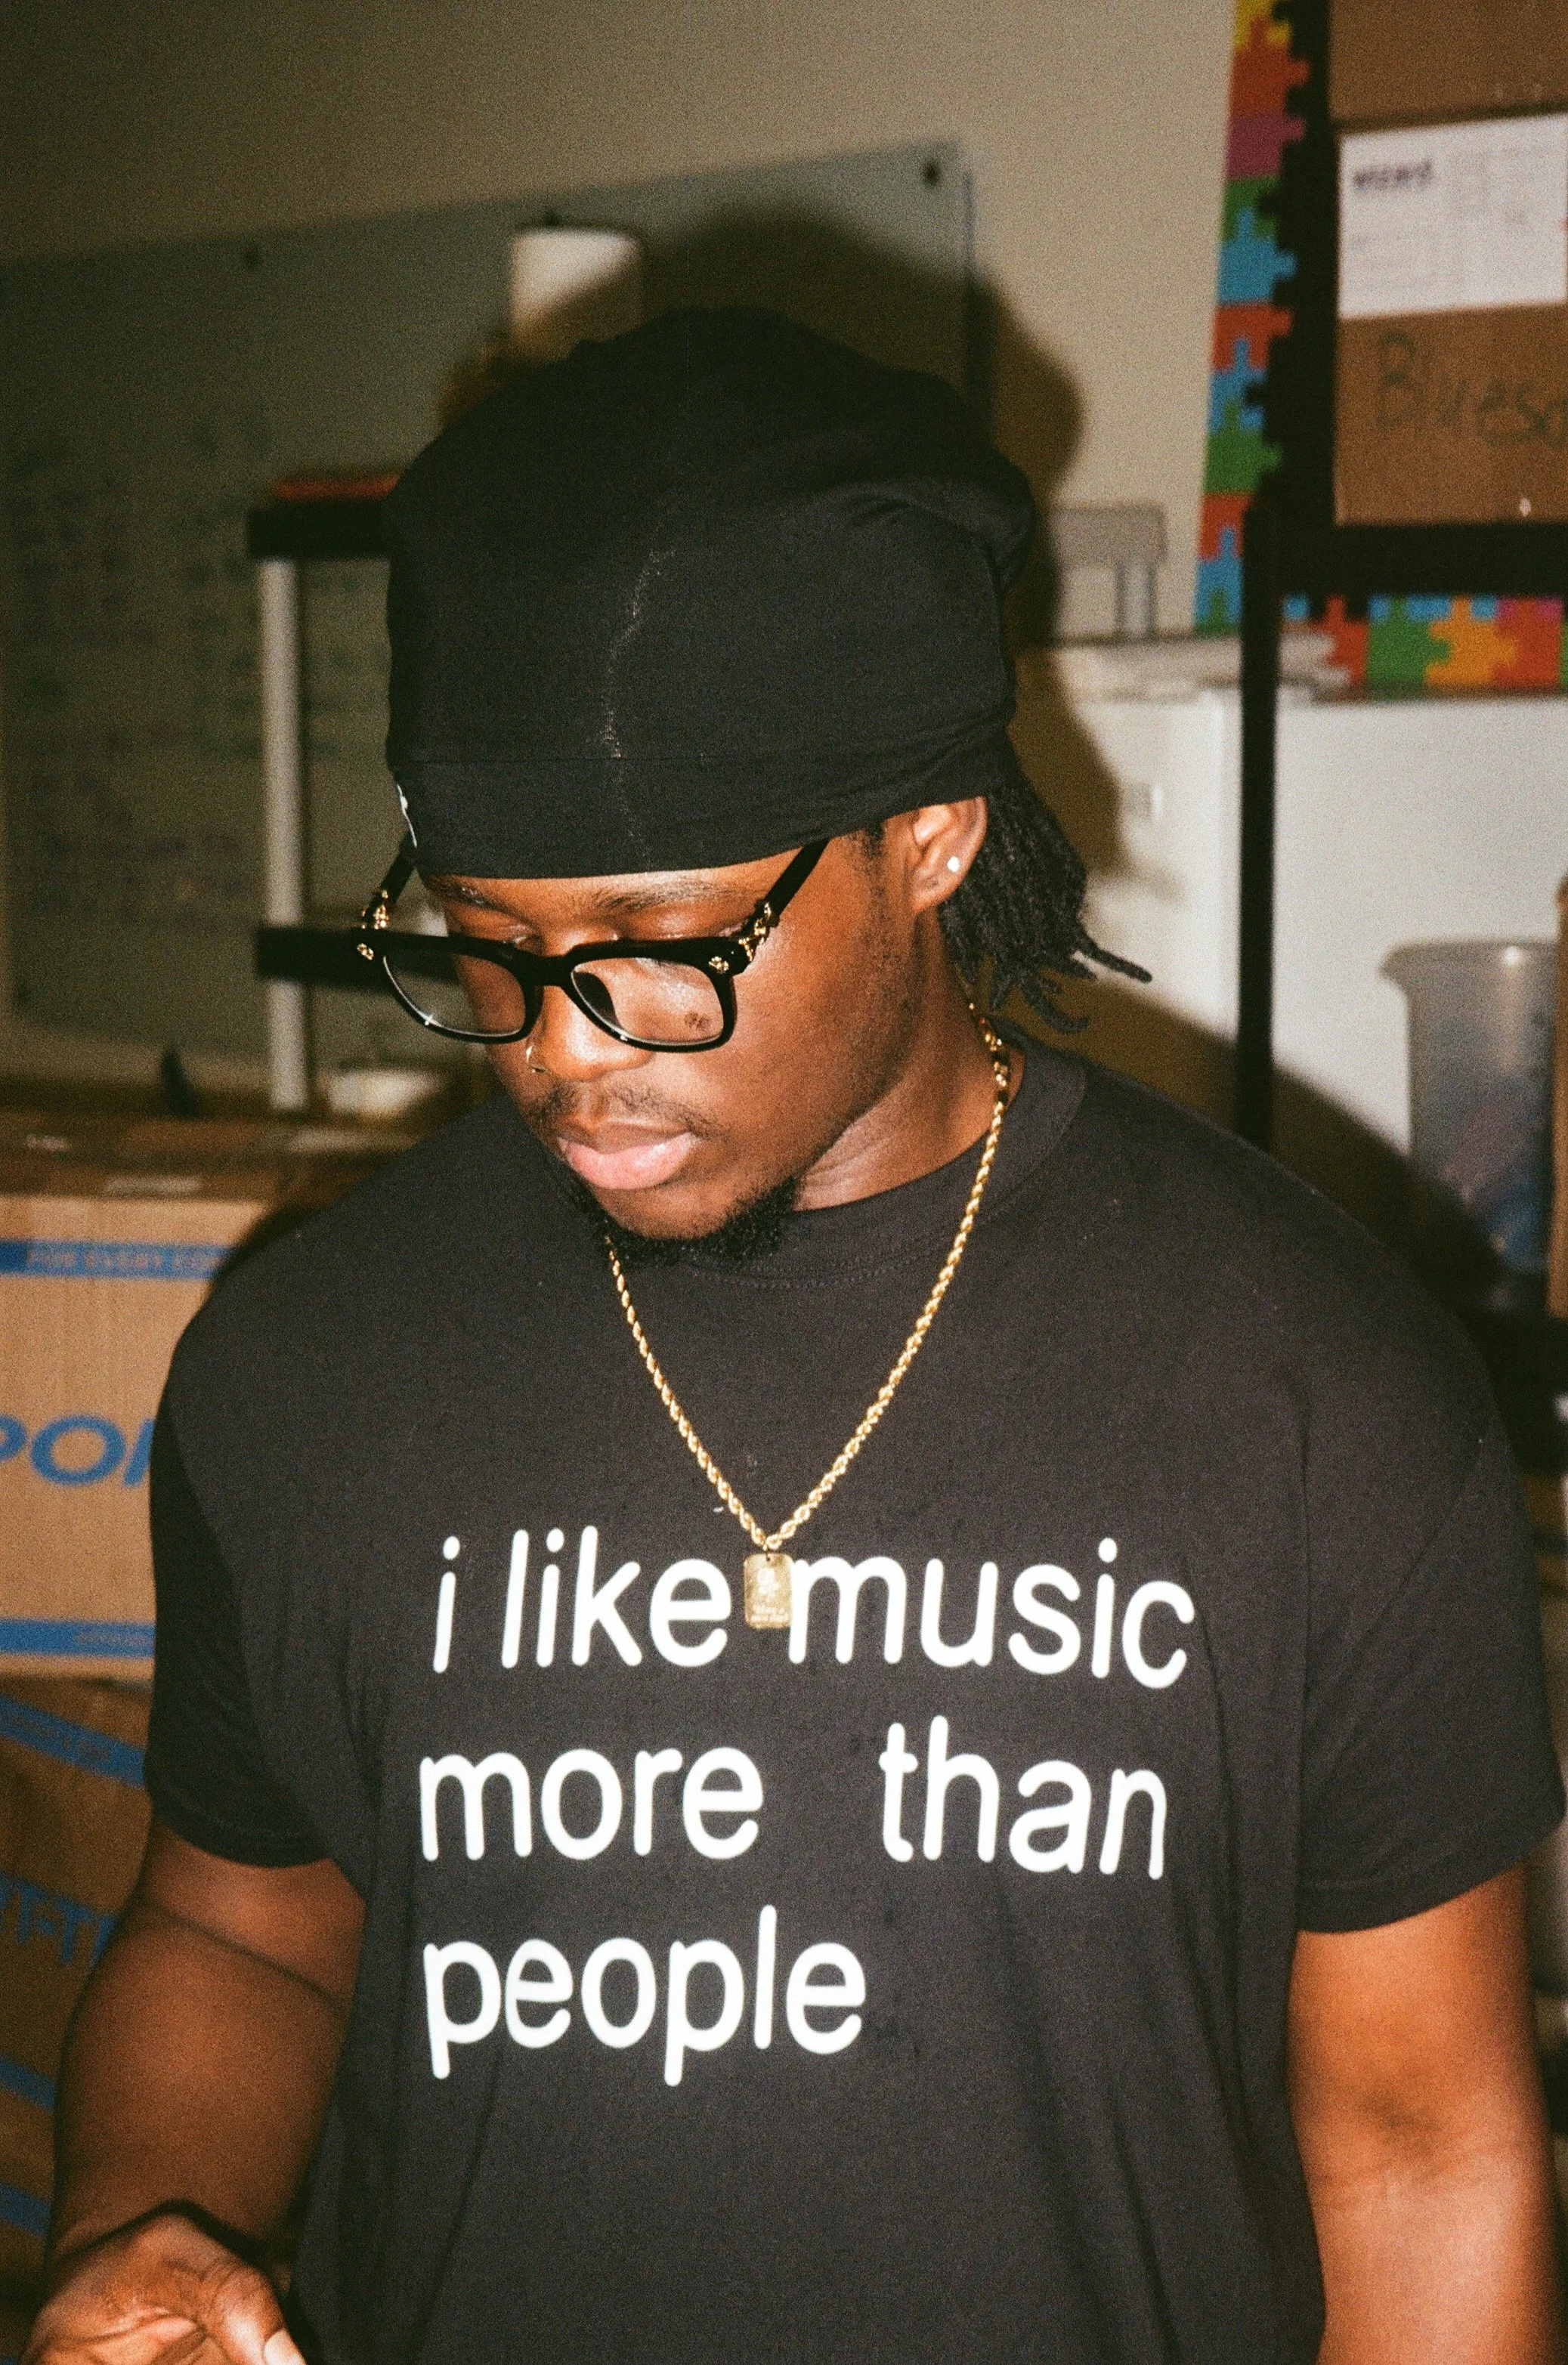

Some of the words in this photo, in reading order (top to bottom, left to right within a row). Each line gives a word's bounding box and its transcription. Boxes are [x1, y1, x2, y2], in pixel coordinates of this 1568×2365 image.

[432, 1535, 461, 1674] i
[500, 1525, 733, 1669] like
[787, 1537, 1196, 1690] music
[419, 1745, 765, 1862] more
[877, 1714, 1168, 1881] than
[422, 1903, 868, 2088] people
